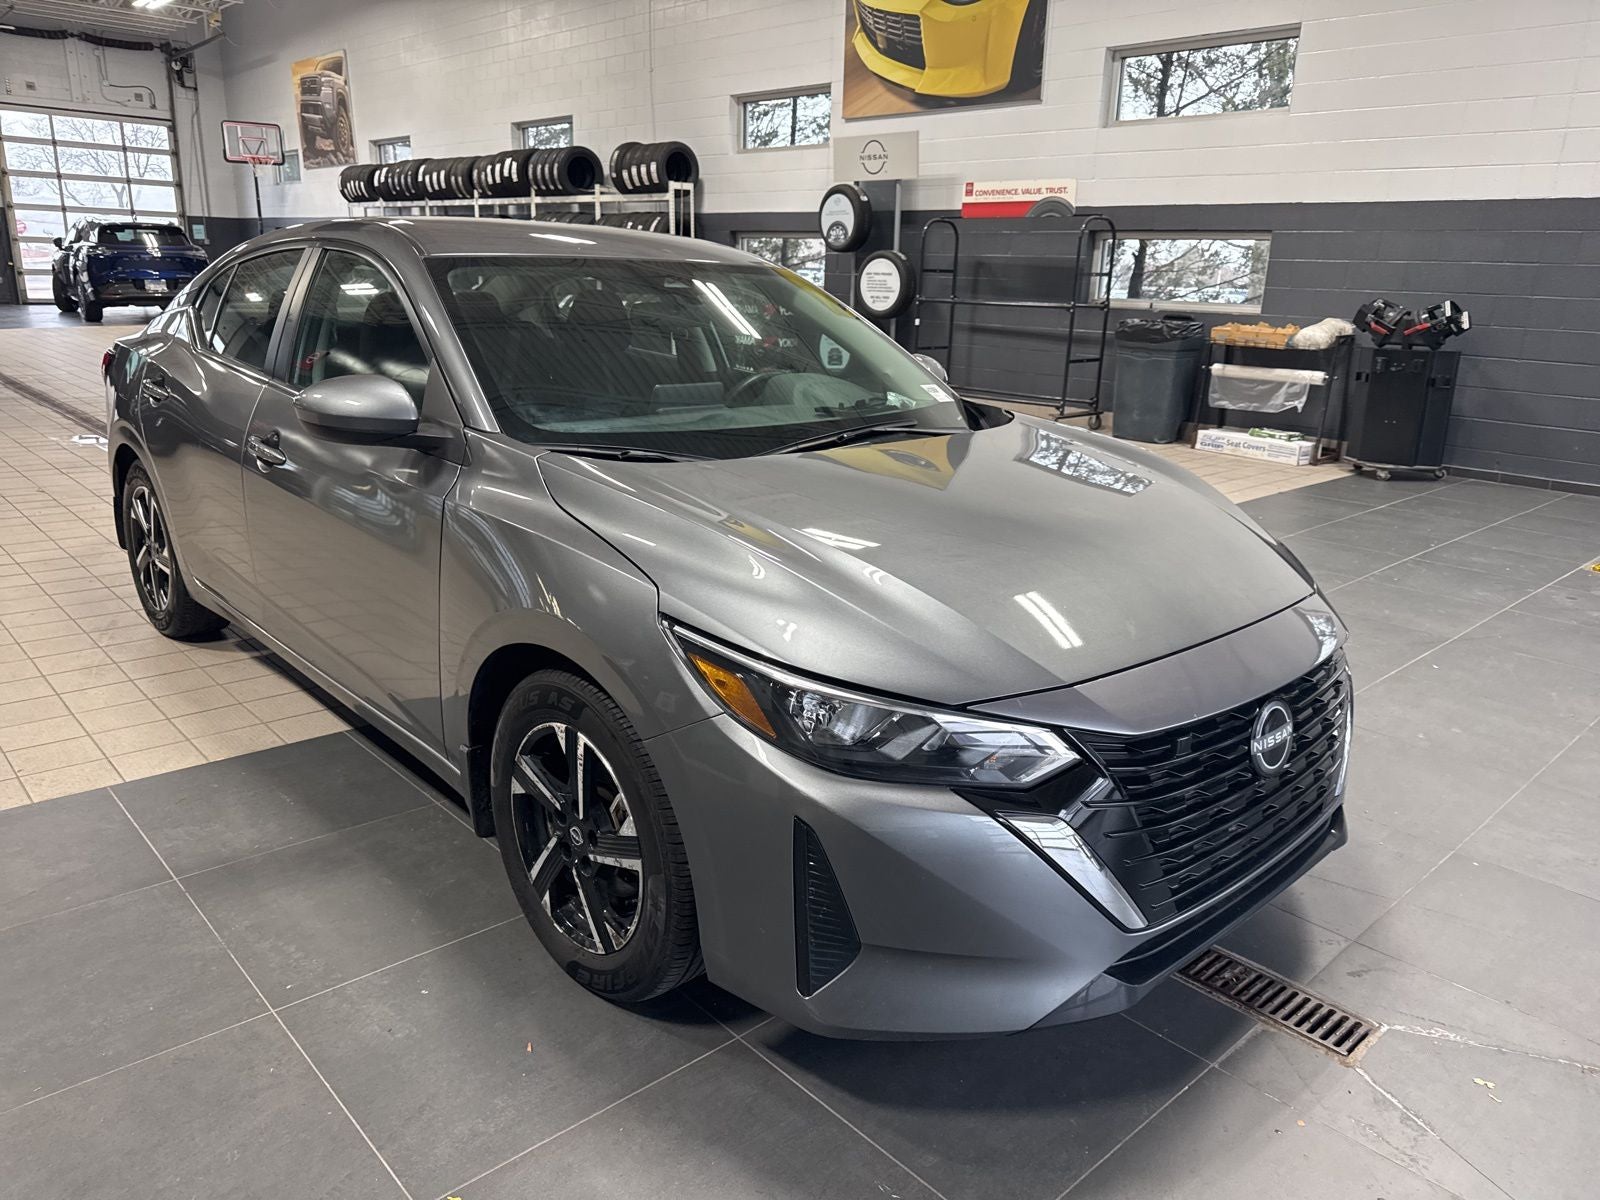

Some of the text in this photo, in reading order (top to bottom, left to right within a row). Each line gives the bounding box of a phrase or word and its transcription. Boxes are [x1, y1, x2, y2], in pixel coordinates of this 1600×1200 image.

[1046, 186, 1069, 194] TRUST.
[1226, 439, 1241, 449] Seat
[1242, 441, 1266, 452] Covers
[1253, 723, 1292, 752] NISSAN
